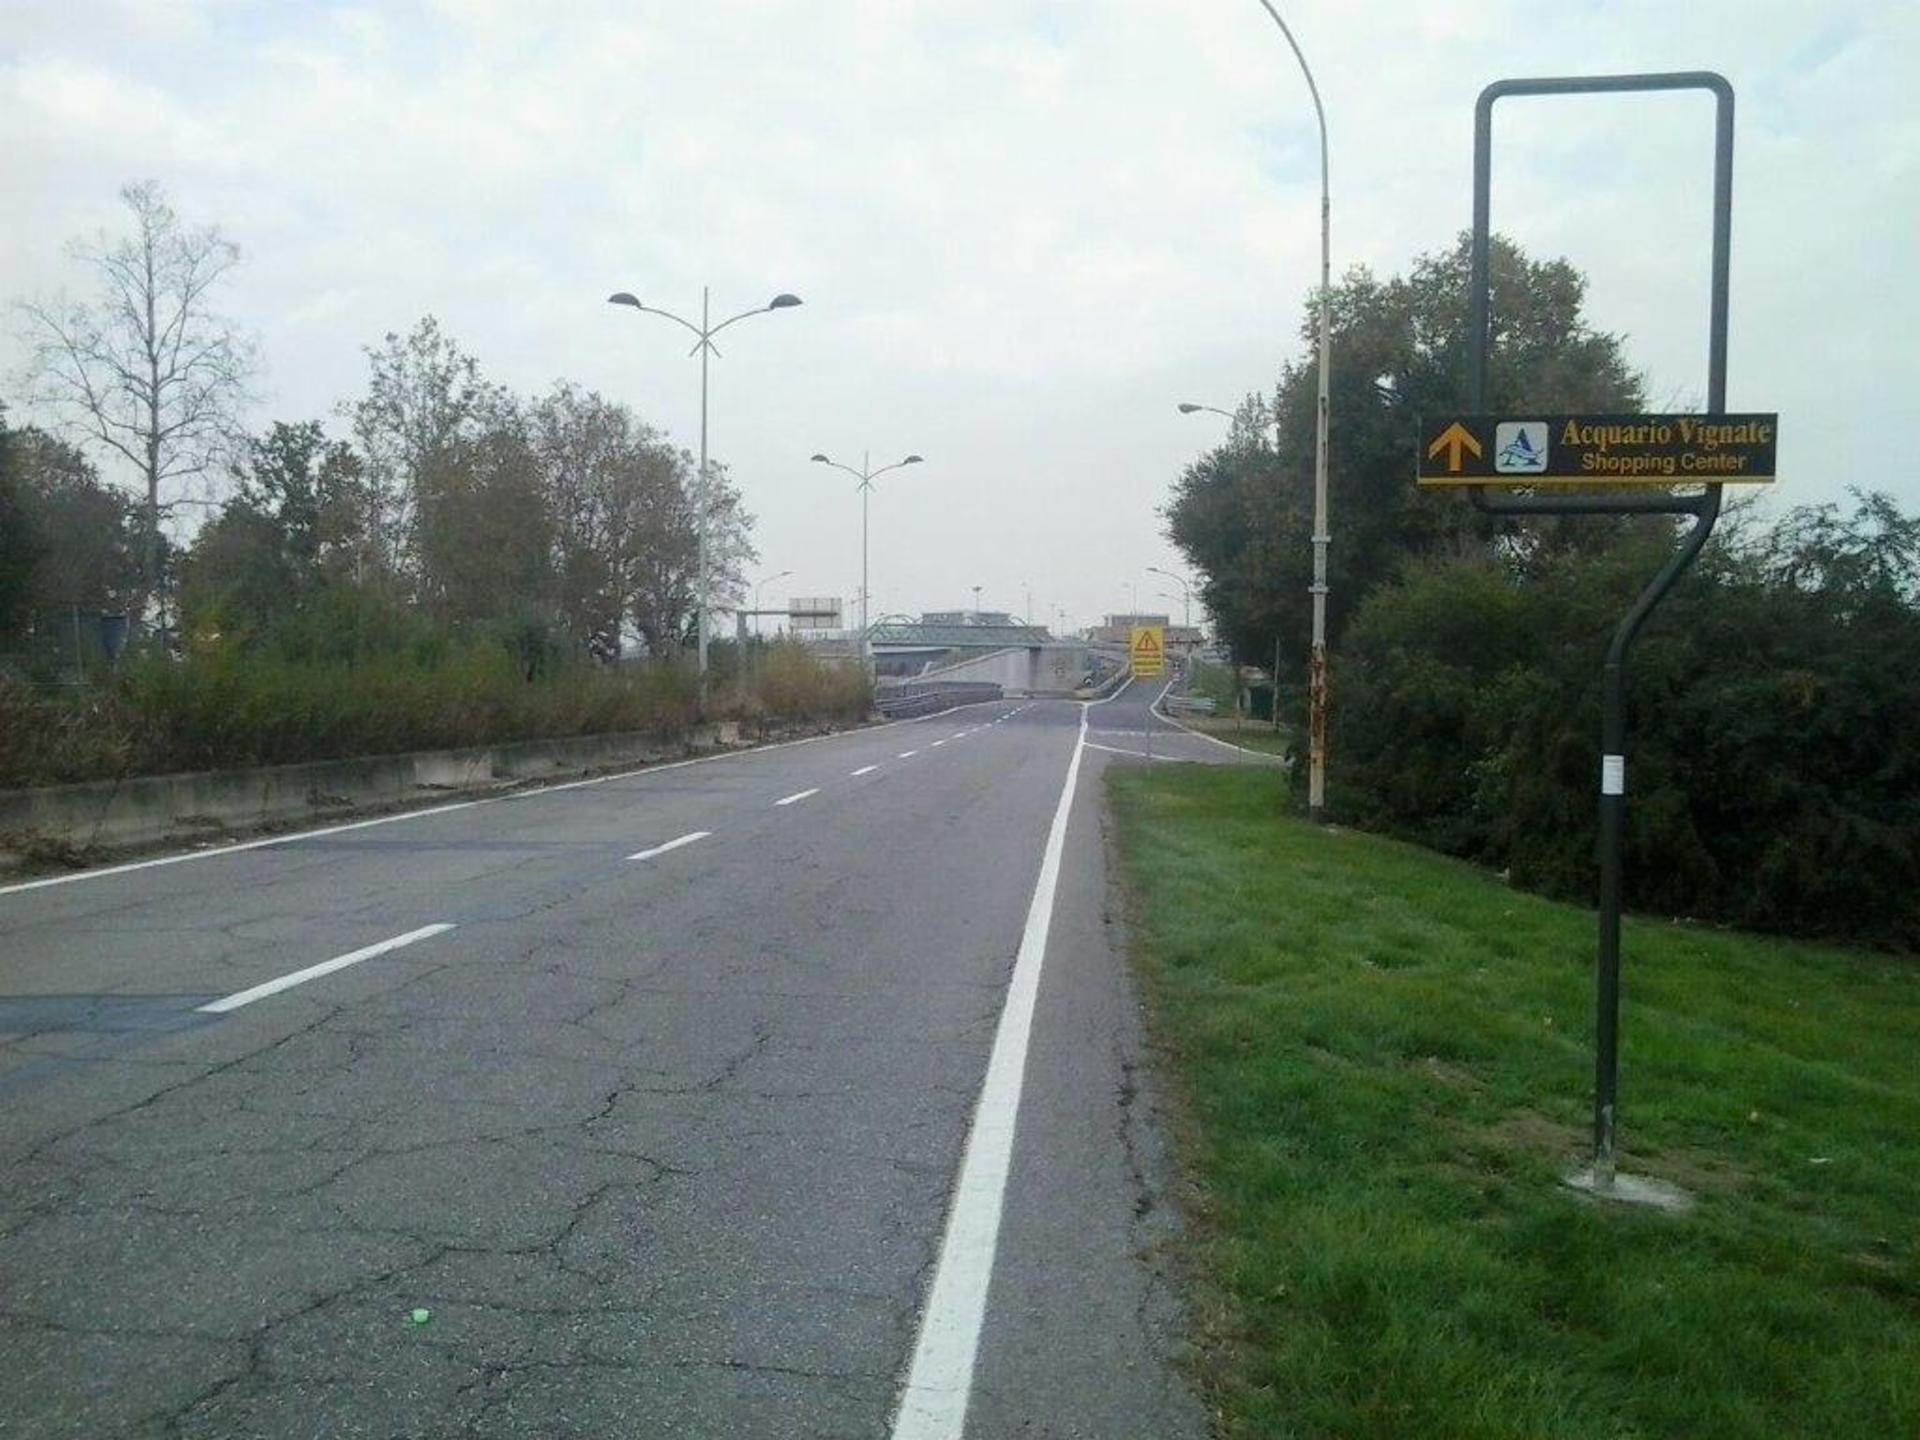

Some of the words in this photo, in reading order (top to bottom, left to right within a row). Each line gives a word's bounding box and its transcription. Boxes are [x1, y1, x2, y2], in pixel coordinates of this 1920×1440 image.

[1560, 419, 1672, 451] Acquario
[1679, 417, 1770, 450] Vignate
[1582, 454, 1675, 474] Shopping
[1681, 453, 1747, 470] Center
